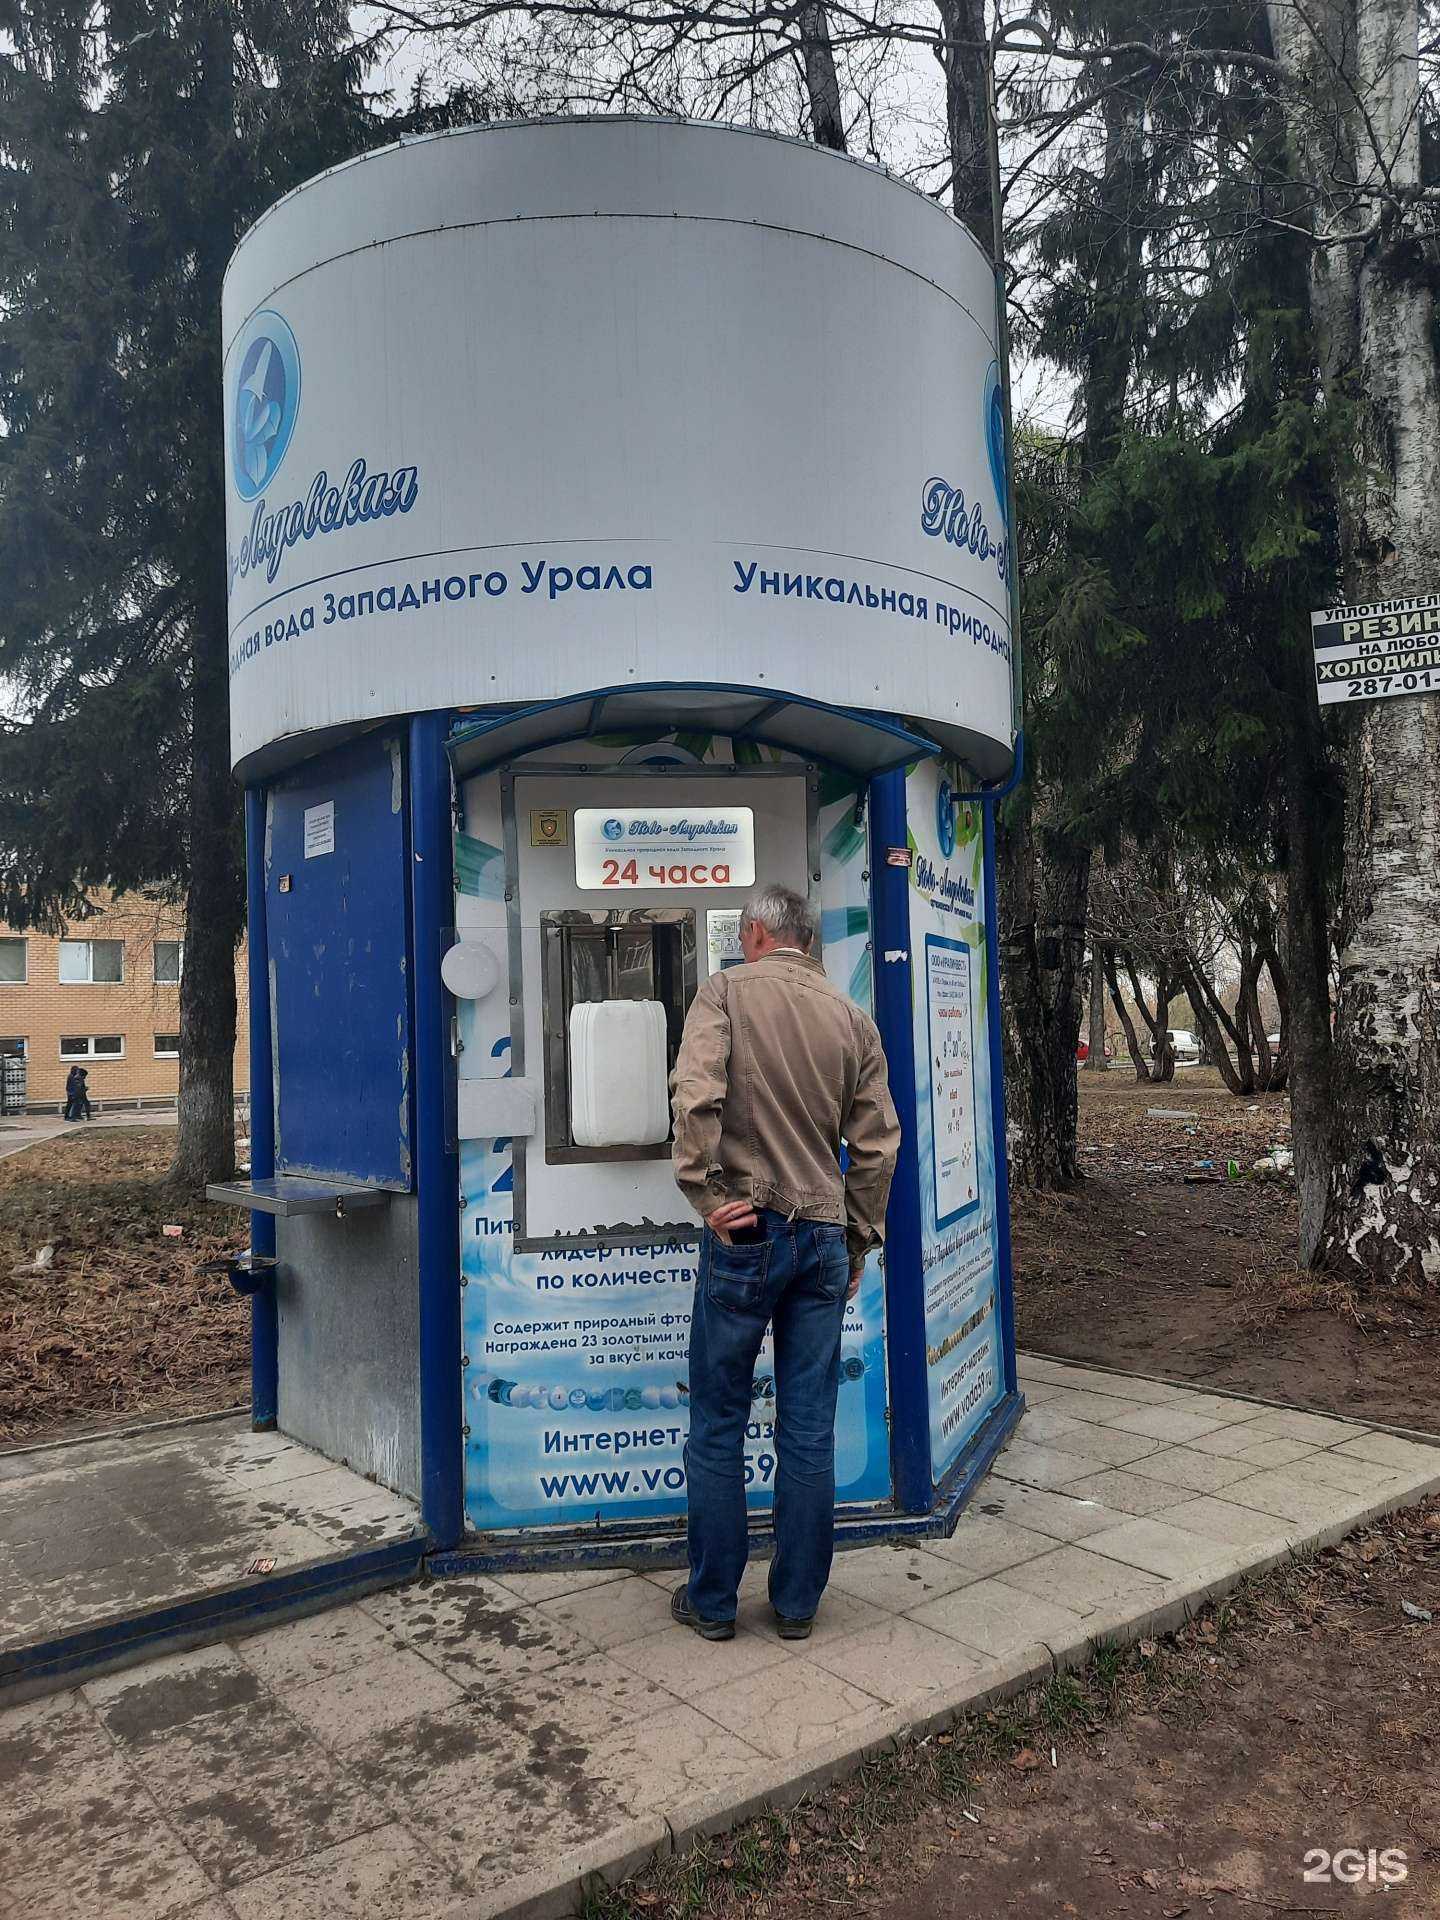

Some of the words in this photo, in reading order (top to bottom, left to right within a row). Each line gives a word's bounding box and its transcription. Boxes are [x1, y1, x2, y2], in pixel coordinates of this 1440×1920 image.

[733, 561, 928, 620] Уникальная
[265, 607, 315, 647] вода
[323, 570, 508, 624] Западного
[520, 560, 653, 599] Урала
[1325, 595, 1440, 621] УПЛОТНИТЕЛ
[1359, 645, 1382, 655] НА
[1387, 635, 1439, 651] ЛЮБО
[602, 859, 639, 885] 24
[649, 864, 731, 884] часа
[536, 1275, 565, 1290] по
[494, 1319, 570, 1335] Содержит
[574, 1313, 656, 1331] природный
[486, 1337, 578, 1354] Награждена
[581, 1335, 598, 1348] 23
[602, 1333, 672, 1346] золотыми
[676, 1332, 685, 1342] и
[589, 1355, 605, 1365] за
[609, 1352, 641, 1368] вкус
[646, 1352, 654, 1361] и
[942, 1368, 992, 1438] www.voda59.ru
